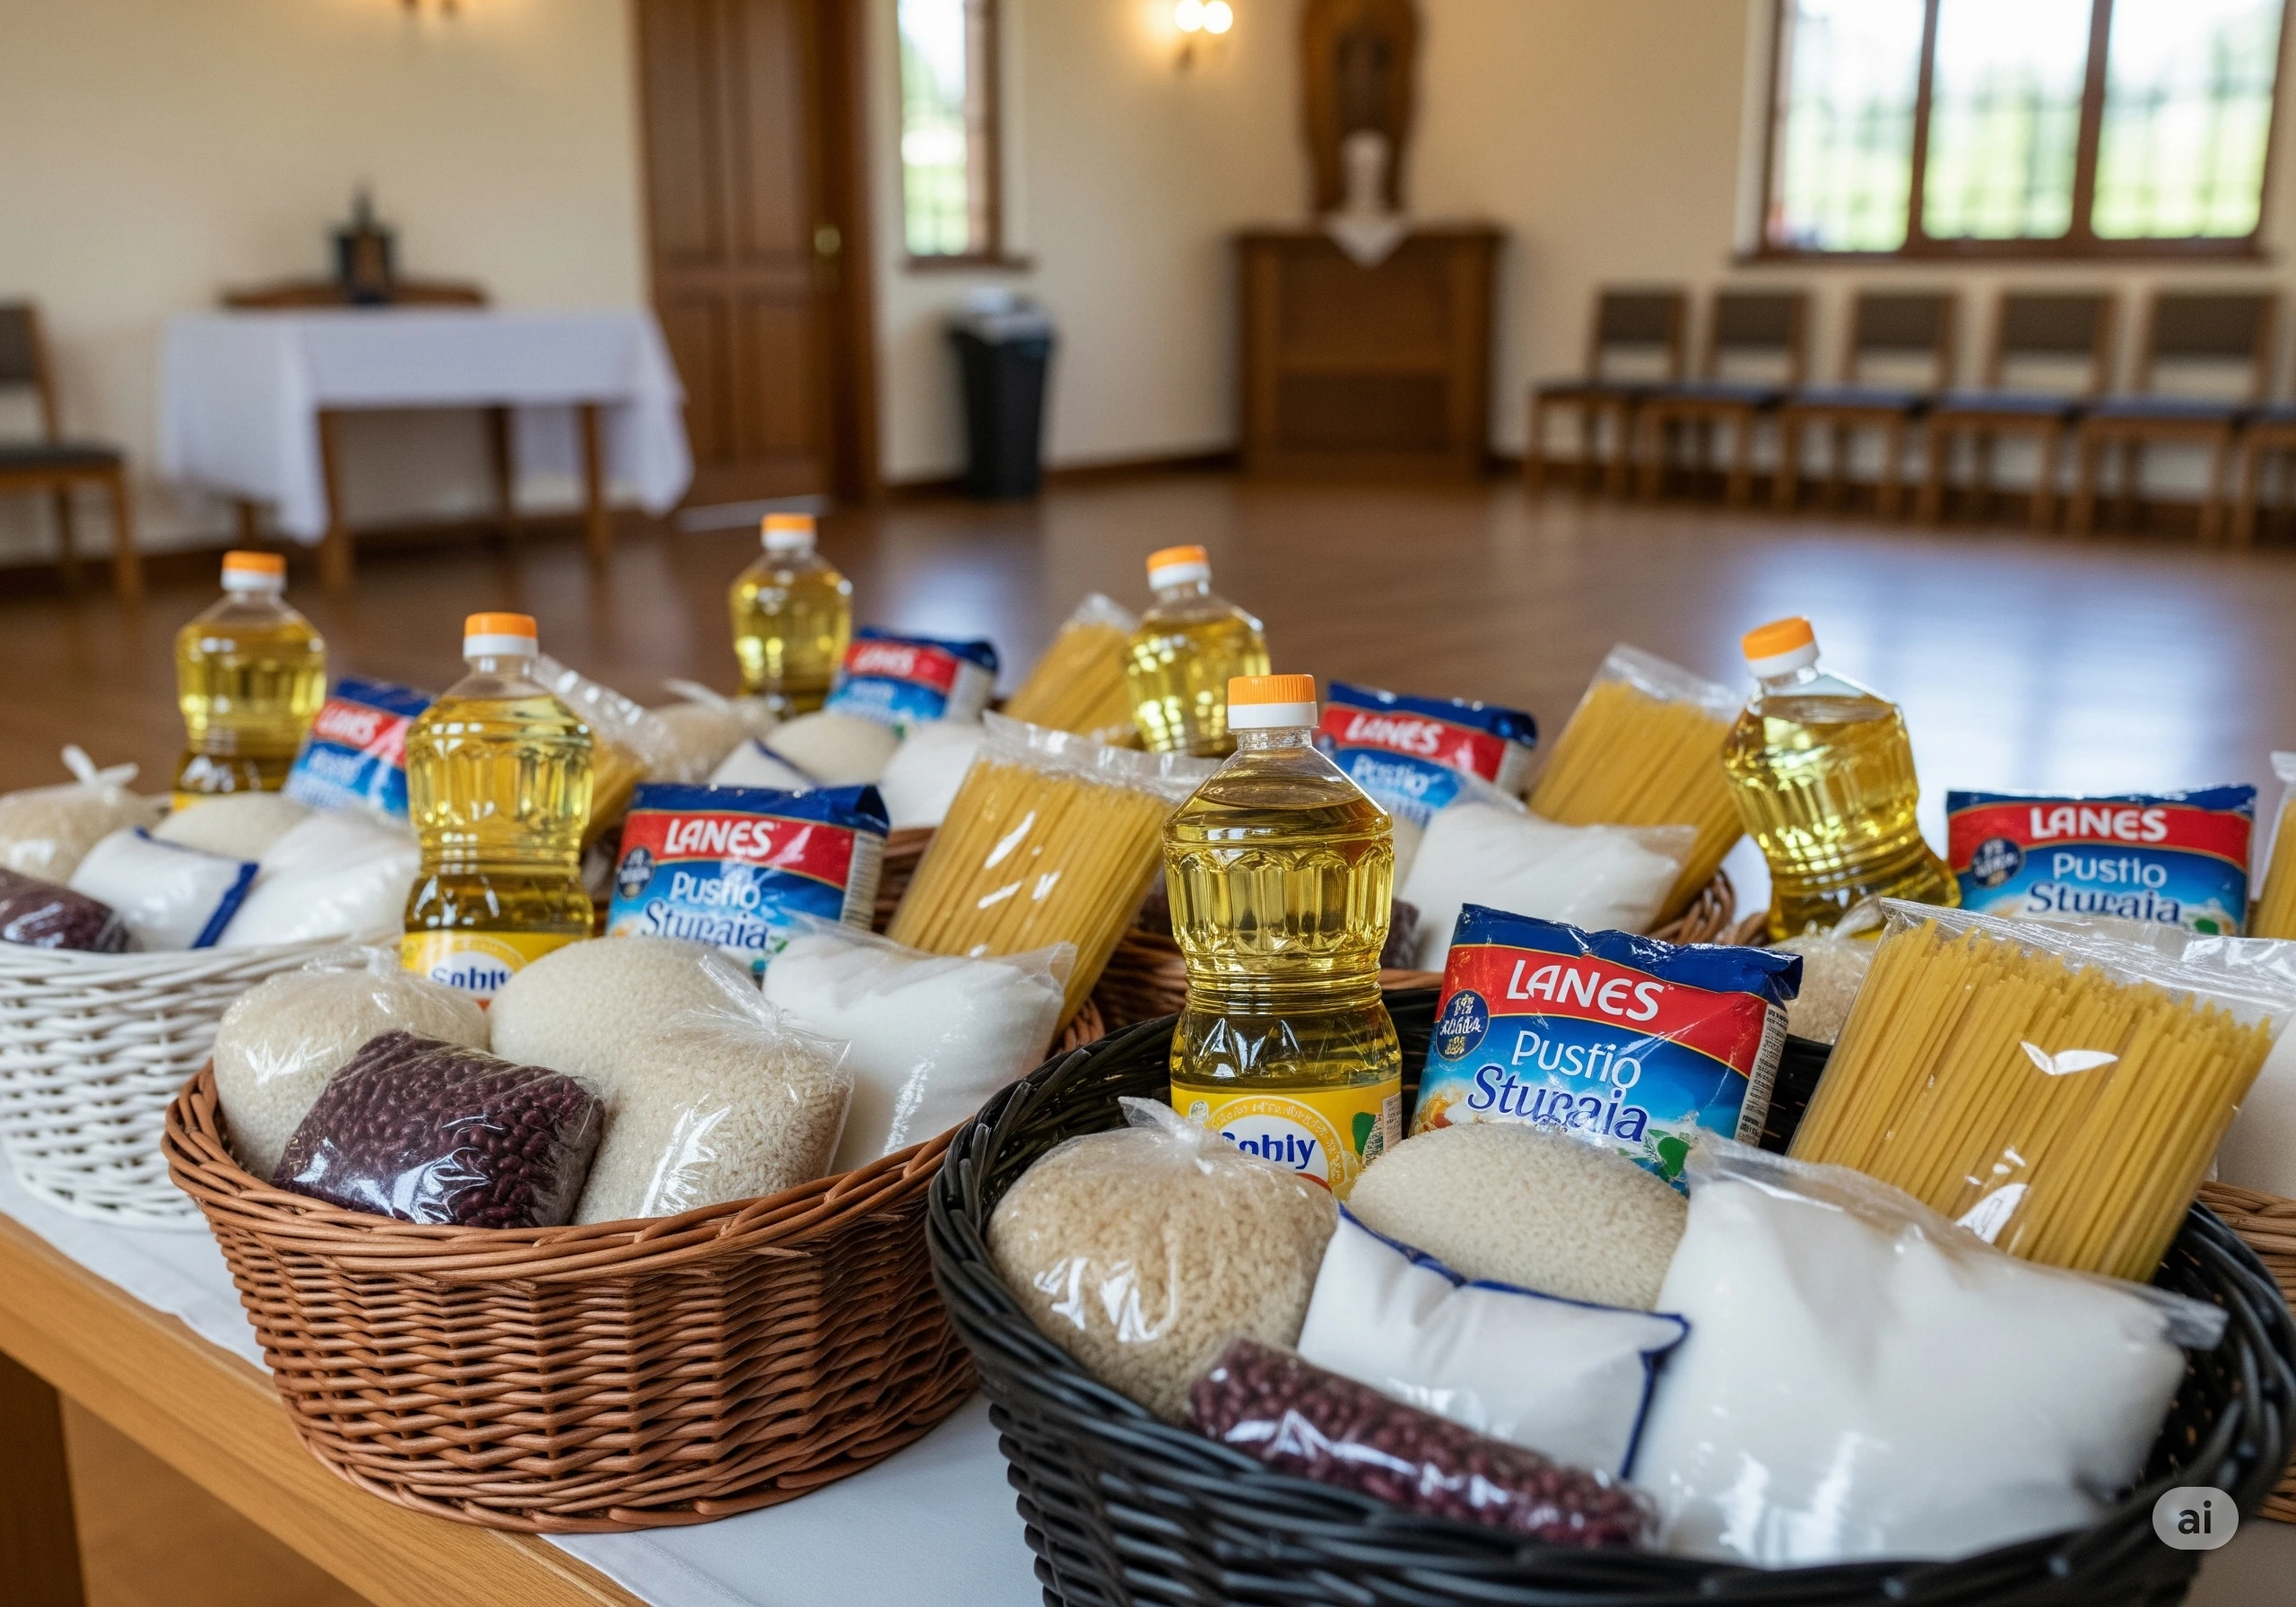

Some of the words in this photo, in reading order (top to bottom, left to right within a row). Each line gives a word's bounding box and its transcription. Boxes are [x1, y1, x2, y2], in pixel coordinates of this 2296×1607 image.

[664, 818, 775, 858] LANES
[2030, 806, 2169, 842] LANES
[1506, 959, 1665, 1022] LANES
